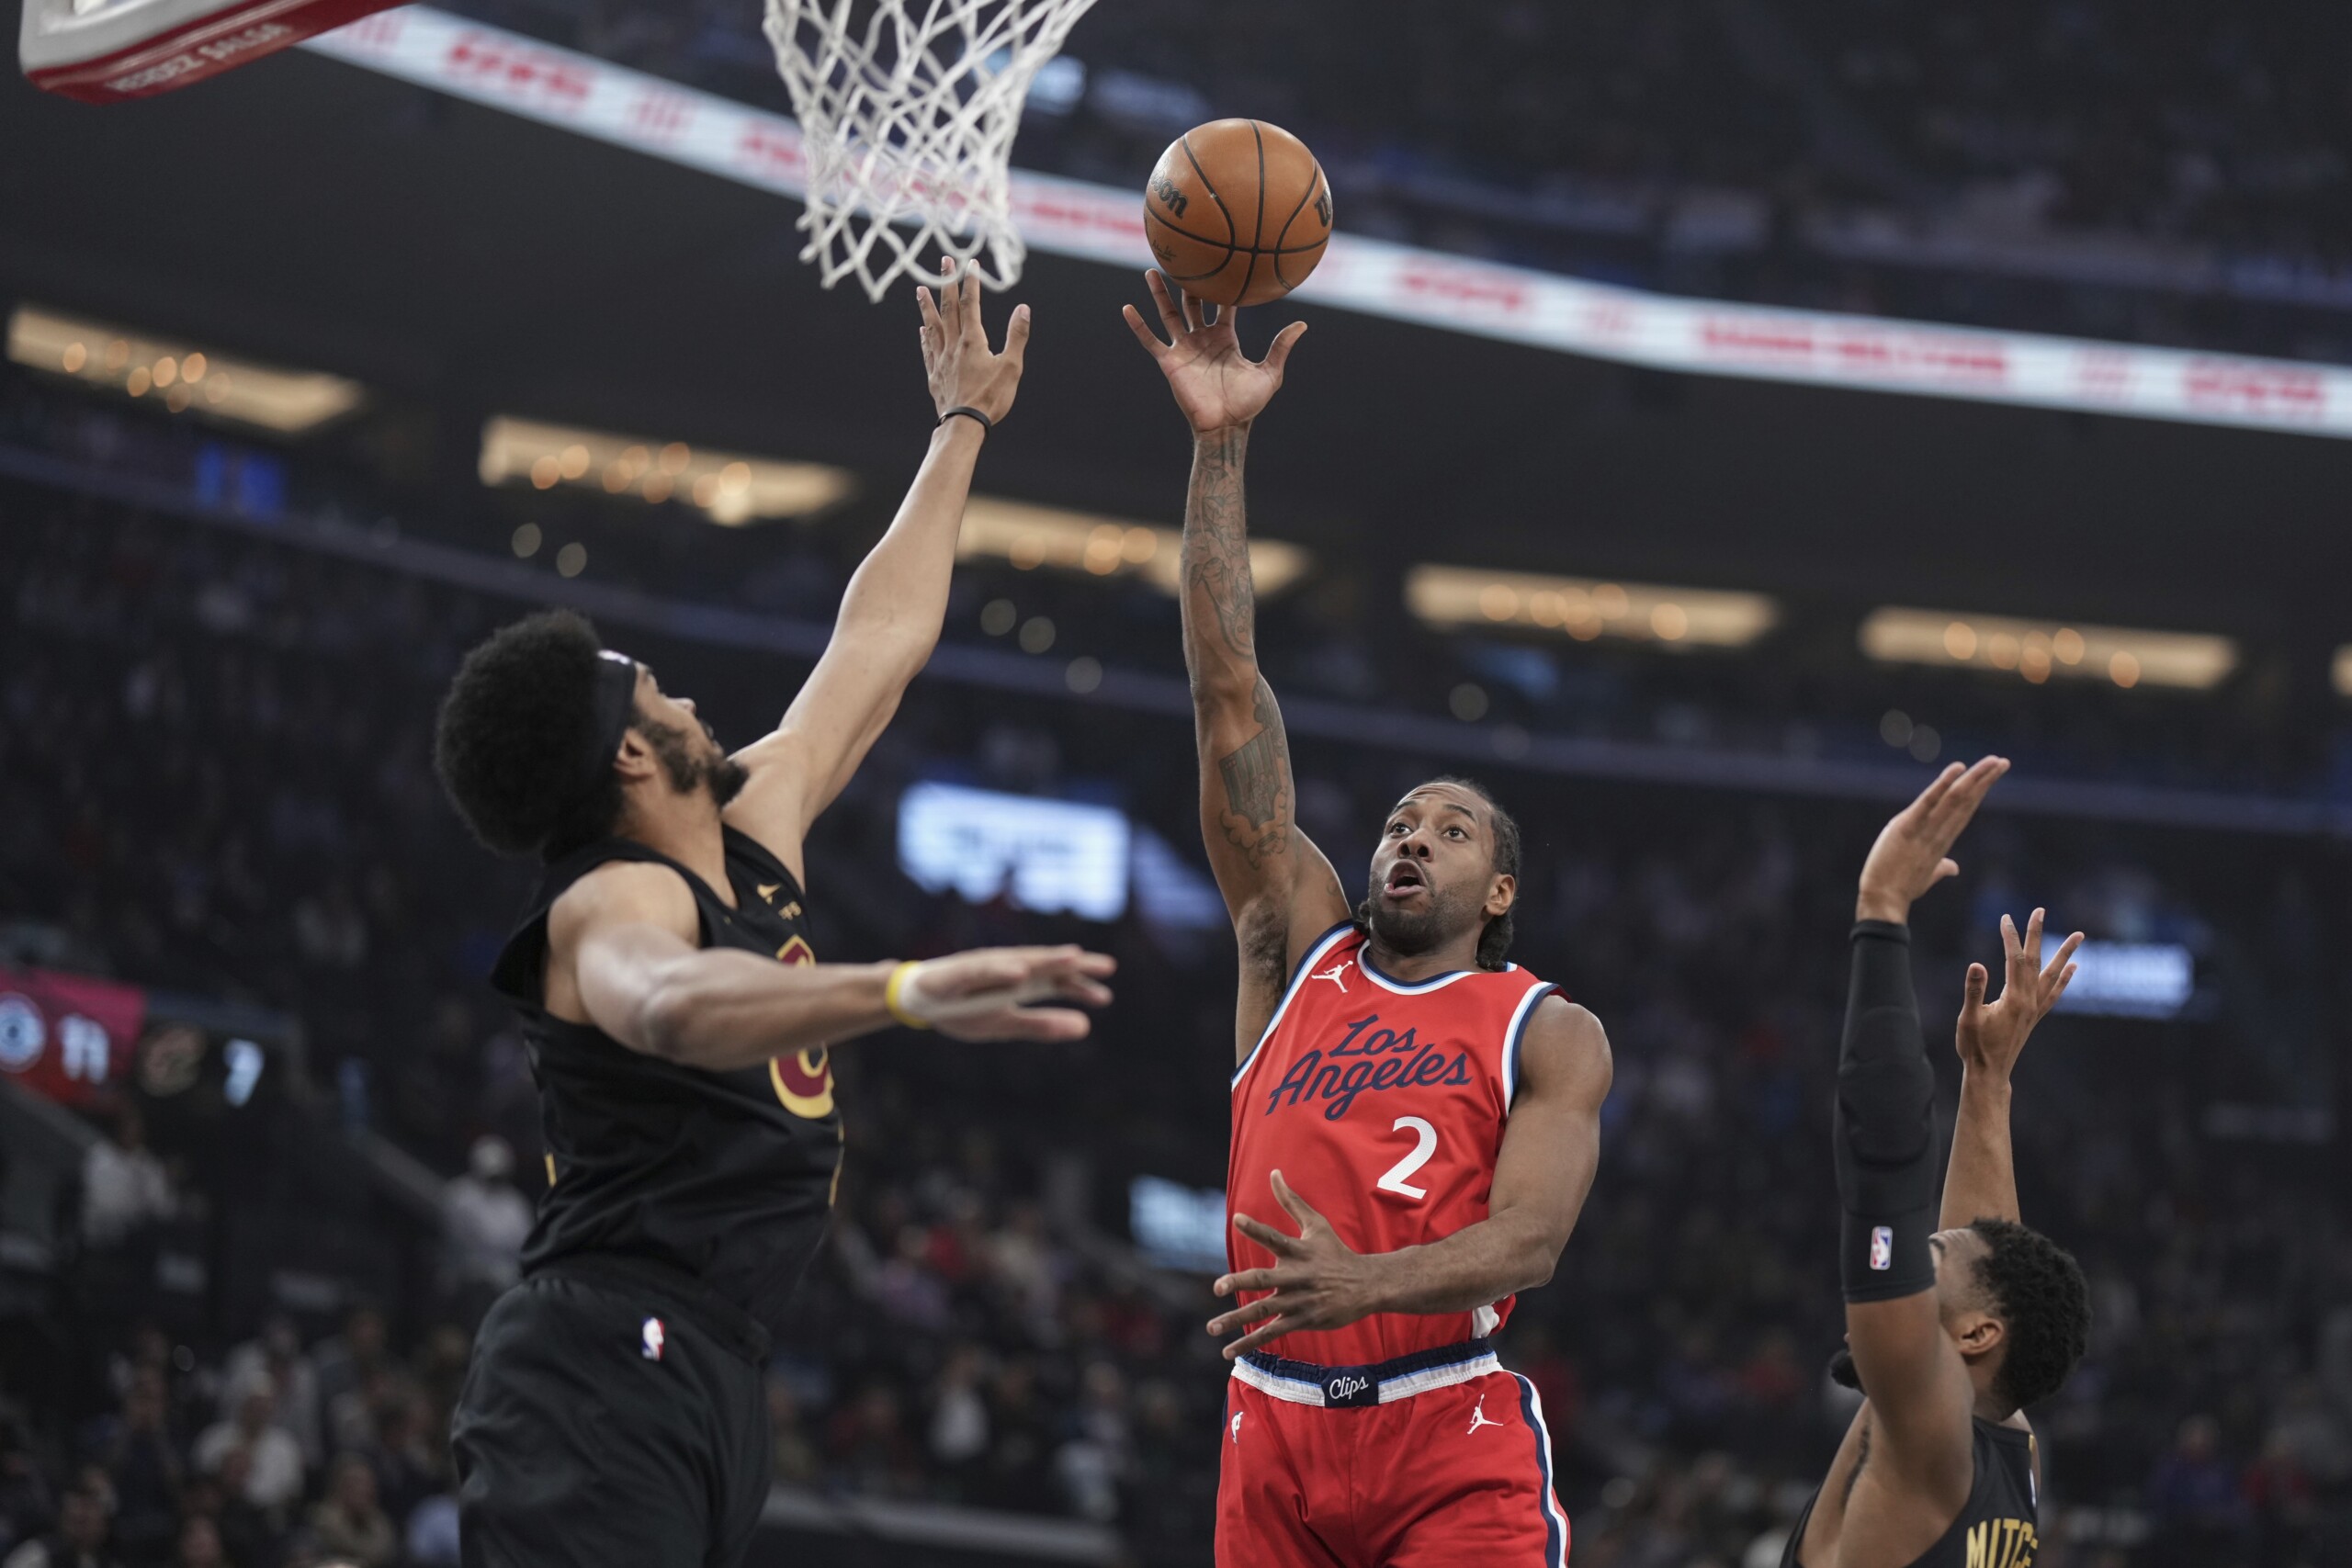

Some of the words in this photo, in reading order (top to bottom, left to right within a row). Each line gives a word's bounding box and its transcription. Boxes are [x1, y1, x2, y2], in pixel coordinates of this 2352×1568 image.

[1328, 1013, 1419, 1058] Los
[1264, 1043, 1474, 1121] Angeles
[1376, 1115, 1438, 1200] 2
[1329, 1376, 1369, 1400] Clips
[1966, 1517, 2039, 1568] MITC
